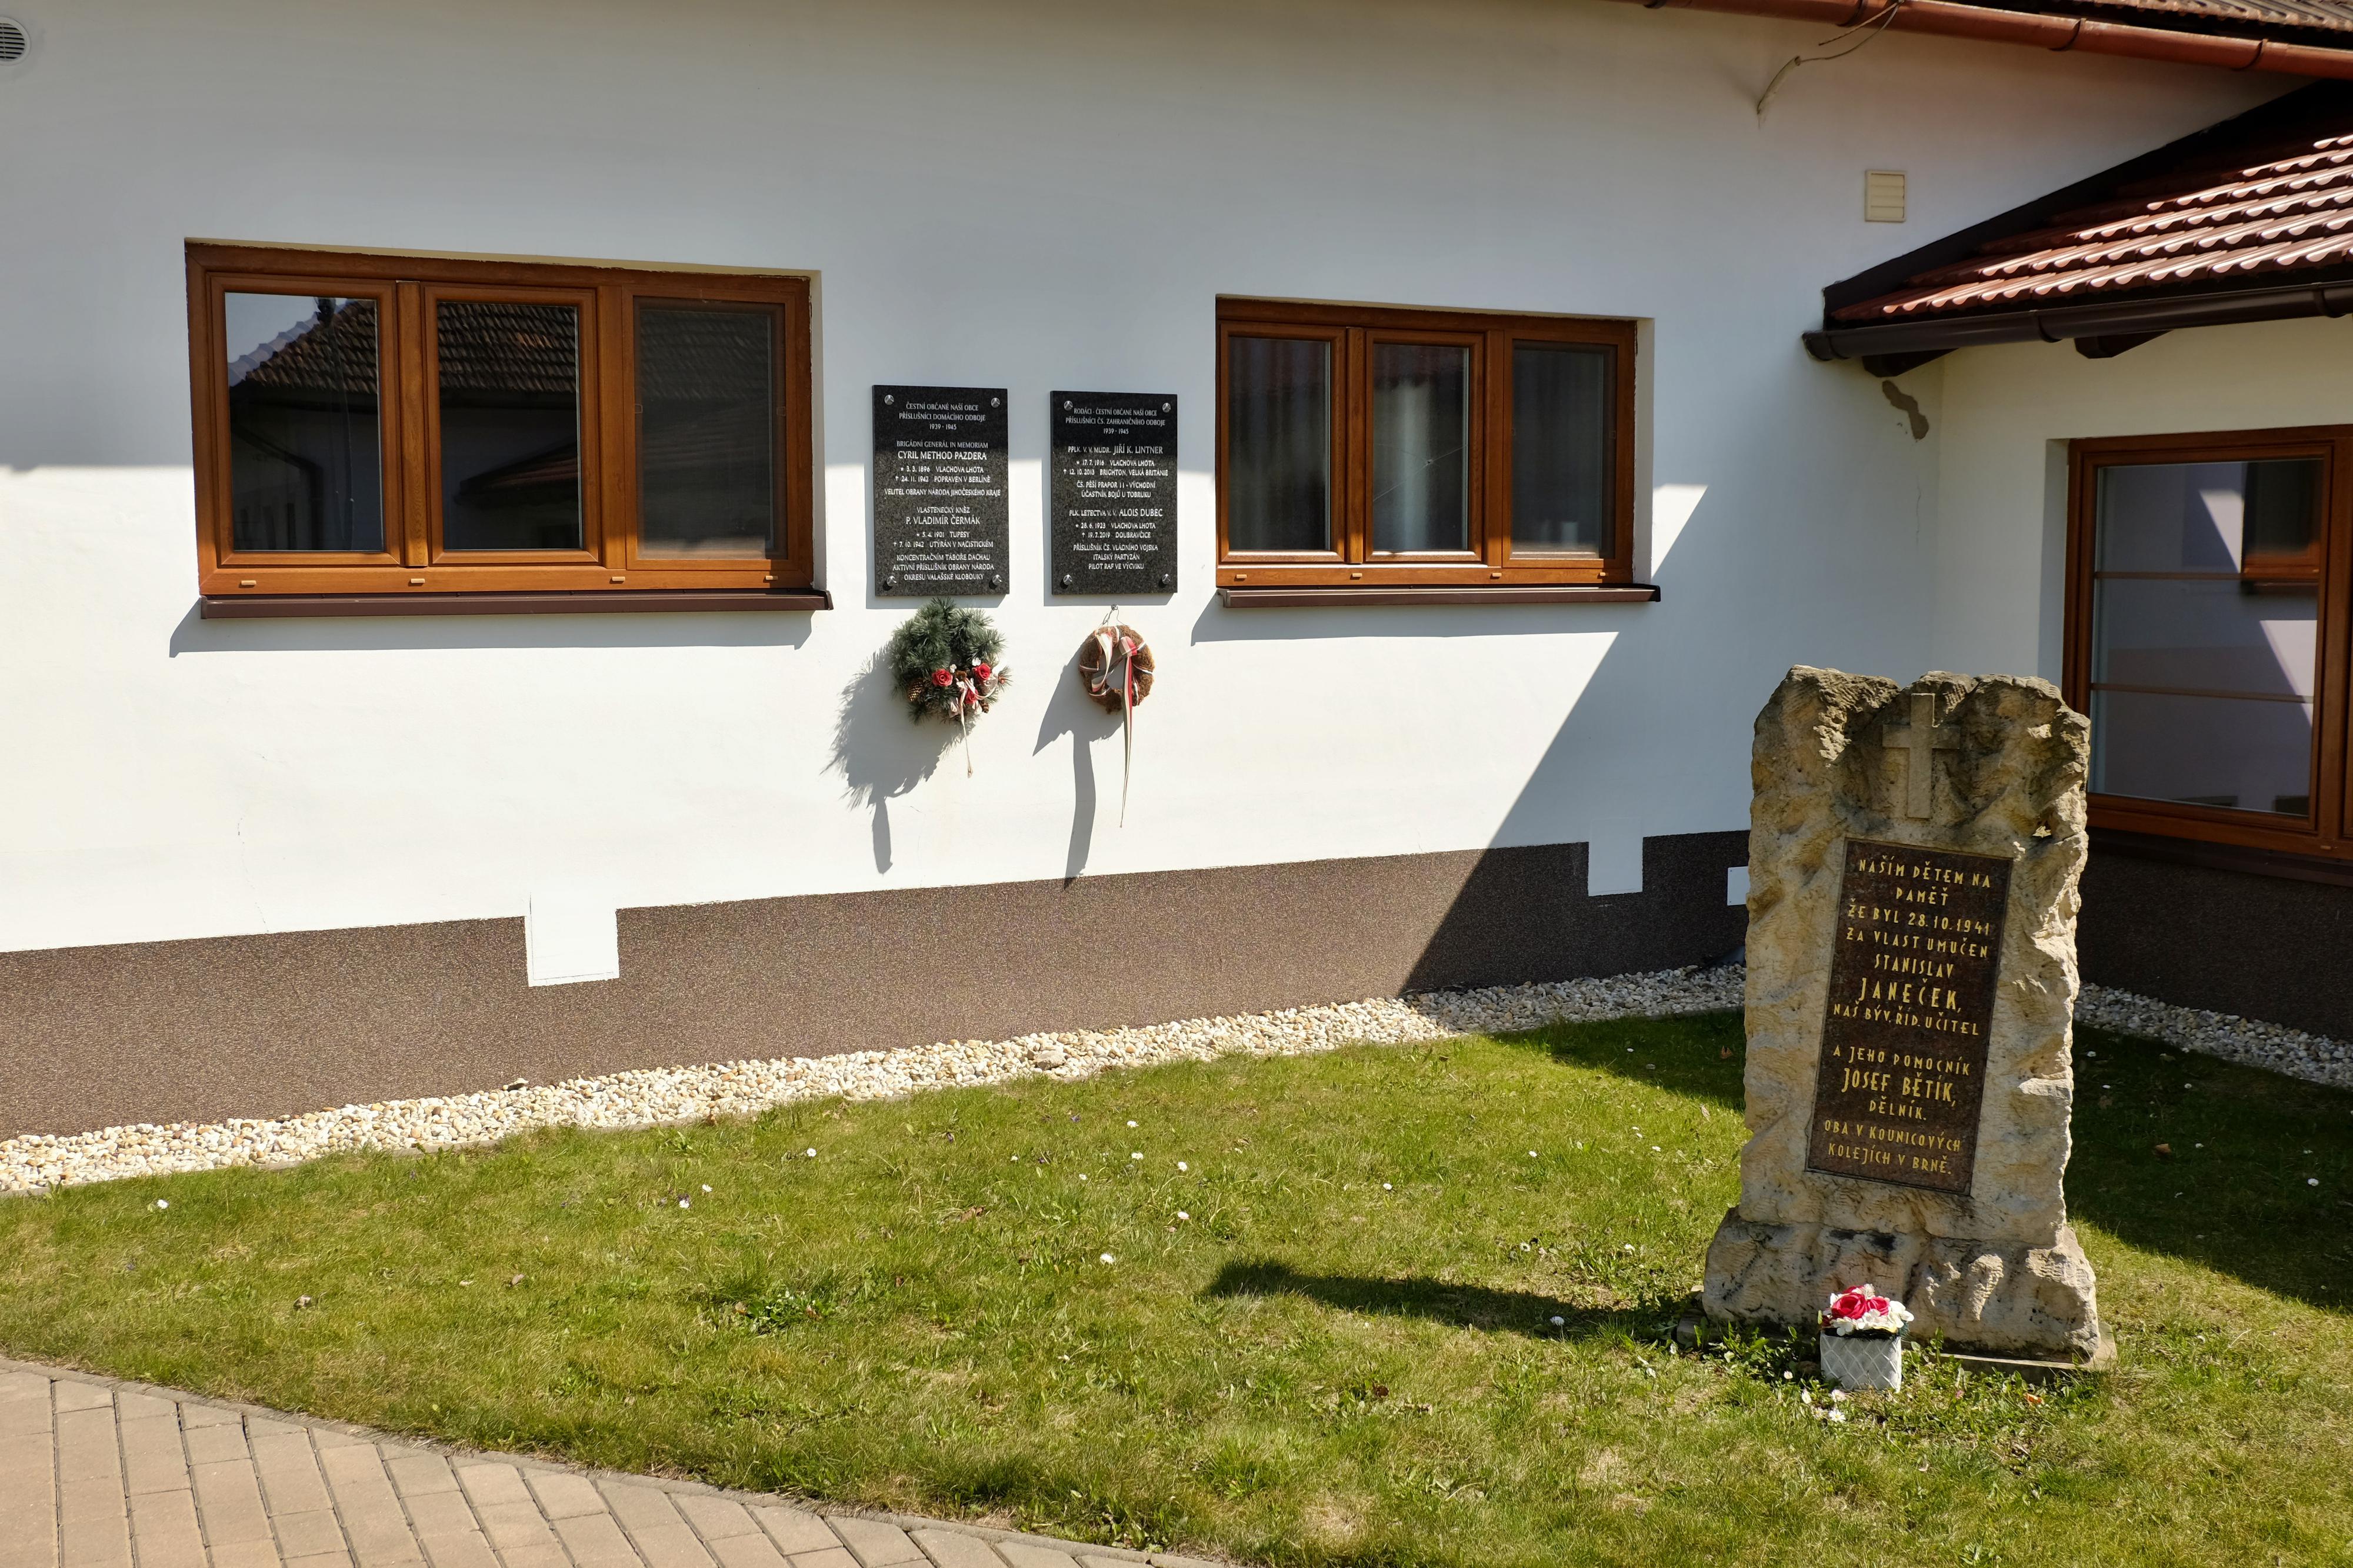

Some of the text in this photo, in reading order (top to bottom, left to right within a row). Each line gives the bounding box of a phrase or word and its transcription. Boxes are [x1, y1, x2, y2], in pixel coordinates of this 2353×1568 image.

[899, 412, 932, 420] PŘÍSLUŠNÍCI
[906, 402, 925, 410] ČESTNÍ
[927, 402, 949, 411] OBČANÉ
[898, 451, 986, 461] CYRIL METHOD PAZDERA
[1113, 444, 1125, 455] JIŘÍ
[951, 488, 985, 496] JIHOČESKÉHO
[1108, 491, 1121, 499] BOJŮ
[914, 515, 948, 524] VLADIMÍR
[951, 515, 980, 525] ČERMÁK
[1859, 856, 1991, 888] NAŠÍM DĚTEM NA
[1896, 886, 1948, 906] PAMĚŤ
[1848, 898, 1866, 919] ŽE
[1873, 908, 1899, 923] BYL
[1846, 927, 1988, 958] ZA VLAST UMUČEN
[1874, 953, 1954, 978] STANISLAV
[1859, 978, 1962, 1013] JANEČEK,
[1833, 1000, 1859, 1017] NAŠ
[1925, 1012, 1979, 1036] UČITEL
[1849, 1046, 1885, 1063] JEHO
[1894, 1054, 1970, 1076] POMOCNÍK
[1841, 1068, 1956, 1107] JOSEF BĚTÍK,
[1869, 1096, 1927, 1120] DĚLNÍK.
[1825, 1119, 1848, 1135] OBA
[1869, 1126, 1961, 1152] KOUNICOVÝCH
[1828, 1143, 1891, 1165] KOLEJÍCH
[1912, 1156, 1952, 1175] BRNĚ.
